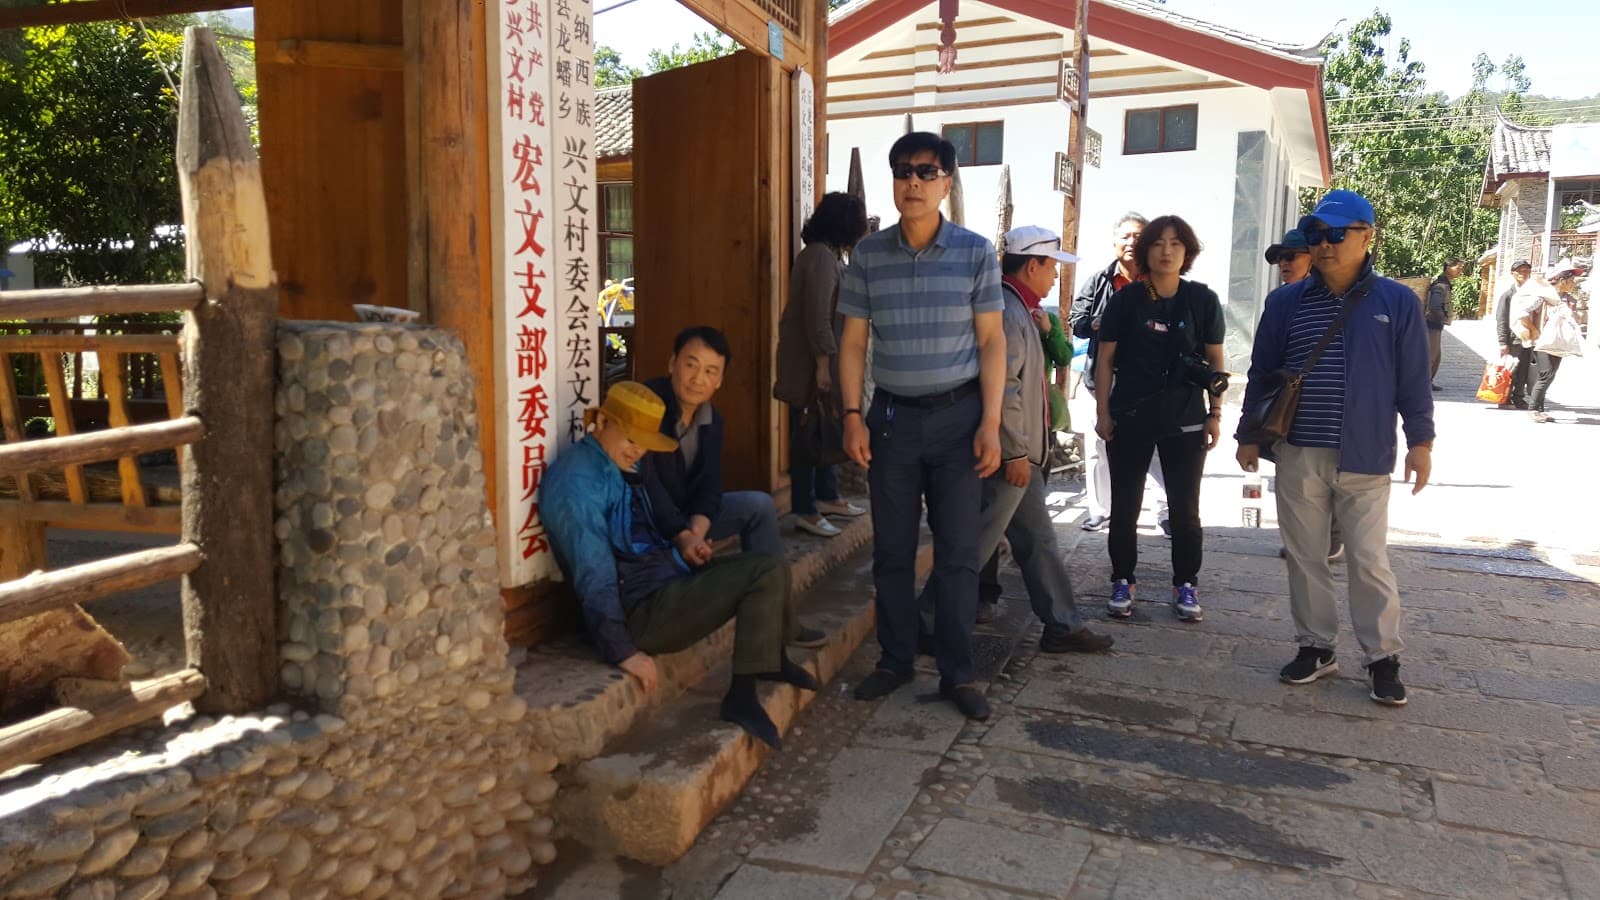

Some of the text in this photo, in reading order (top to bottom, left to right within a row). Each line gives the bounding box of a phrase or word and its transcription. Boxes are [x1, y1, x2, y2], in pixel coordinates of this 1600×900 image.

[505, 0, 525, 120] 兴文村
[526, 0, 545, 126] 共产党
[574, 0, 591, 127] 纳西族
[512, 134, 549, 560] 宏文支部委员会
[562, 136, 592, 443] 兴文村委会宏文村
